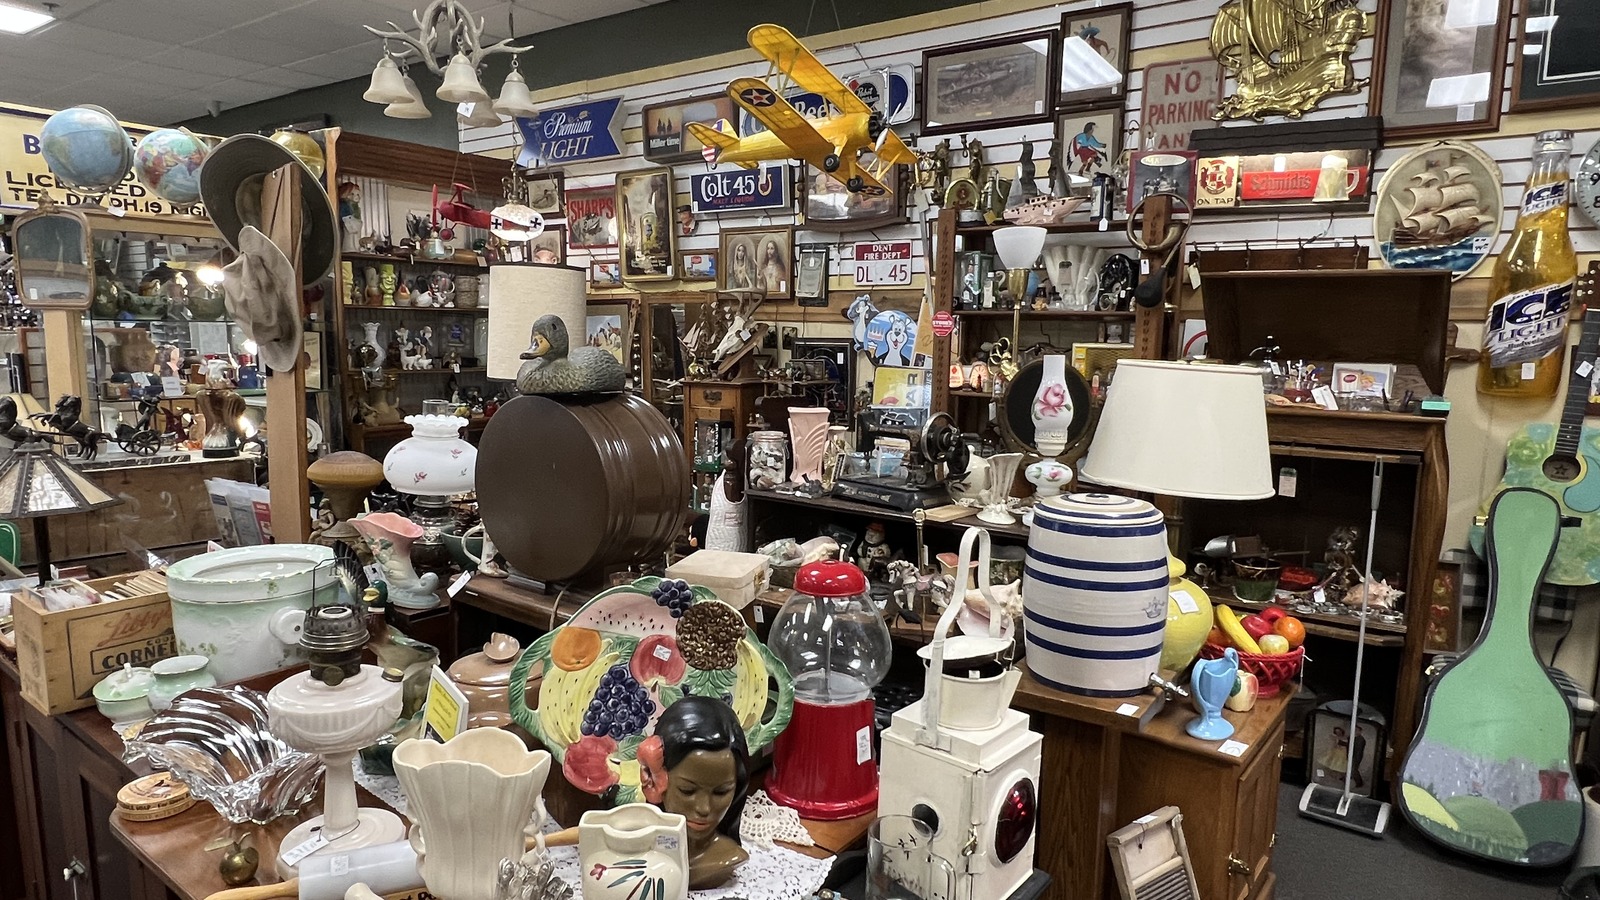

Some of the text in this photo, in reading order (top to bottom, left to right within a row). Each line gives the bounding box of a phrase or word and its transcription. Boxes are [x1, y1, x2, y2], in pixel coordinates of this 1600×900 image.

[1164, 70, 1202, 96] NO
[544, 111, 592, 139] Premium
[1148, 100, 1214, 125] PARKING
[539, 135, 593, 160] LIGHT
[650, 136, 680, 149] Miller time
[1158, 132, 1191, 150] AN
[6, 170, 146, 197] LICED
[700, 173, 756, 203] Colt 45
[1525, 183, 1566, 206] ICE
[570, 197, 615, 224] SHARPS
[1214, 197, 1234, 205] TAP
[864, 252, 879, 260] FIRE
[872, 243, 893, 252] DENT
[856, 265, 873, 283] DL
[888, 264, 908, 282] 45
[1490, 282, 1573, 332] ICE
[1498, 316, 1565, 342] LIGHT
